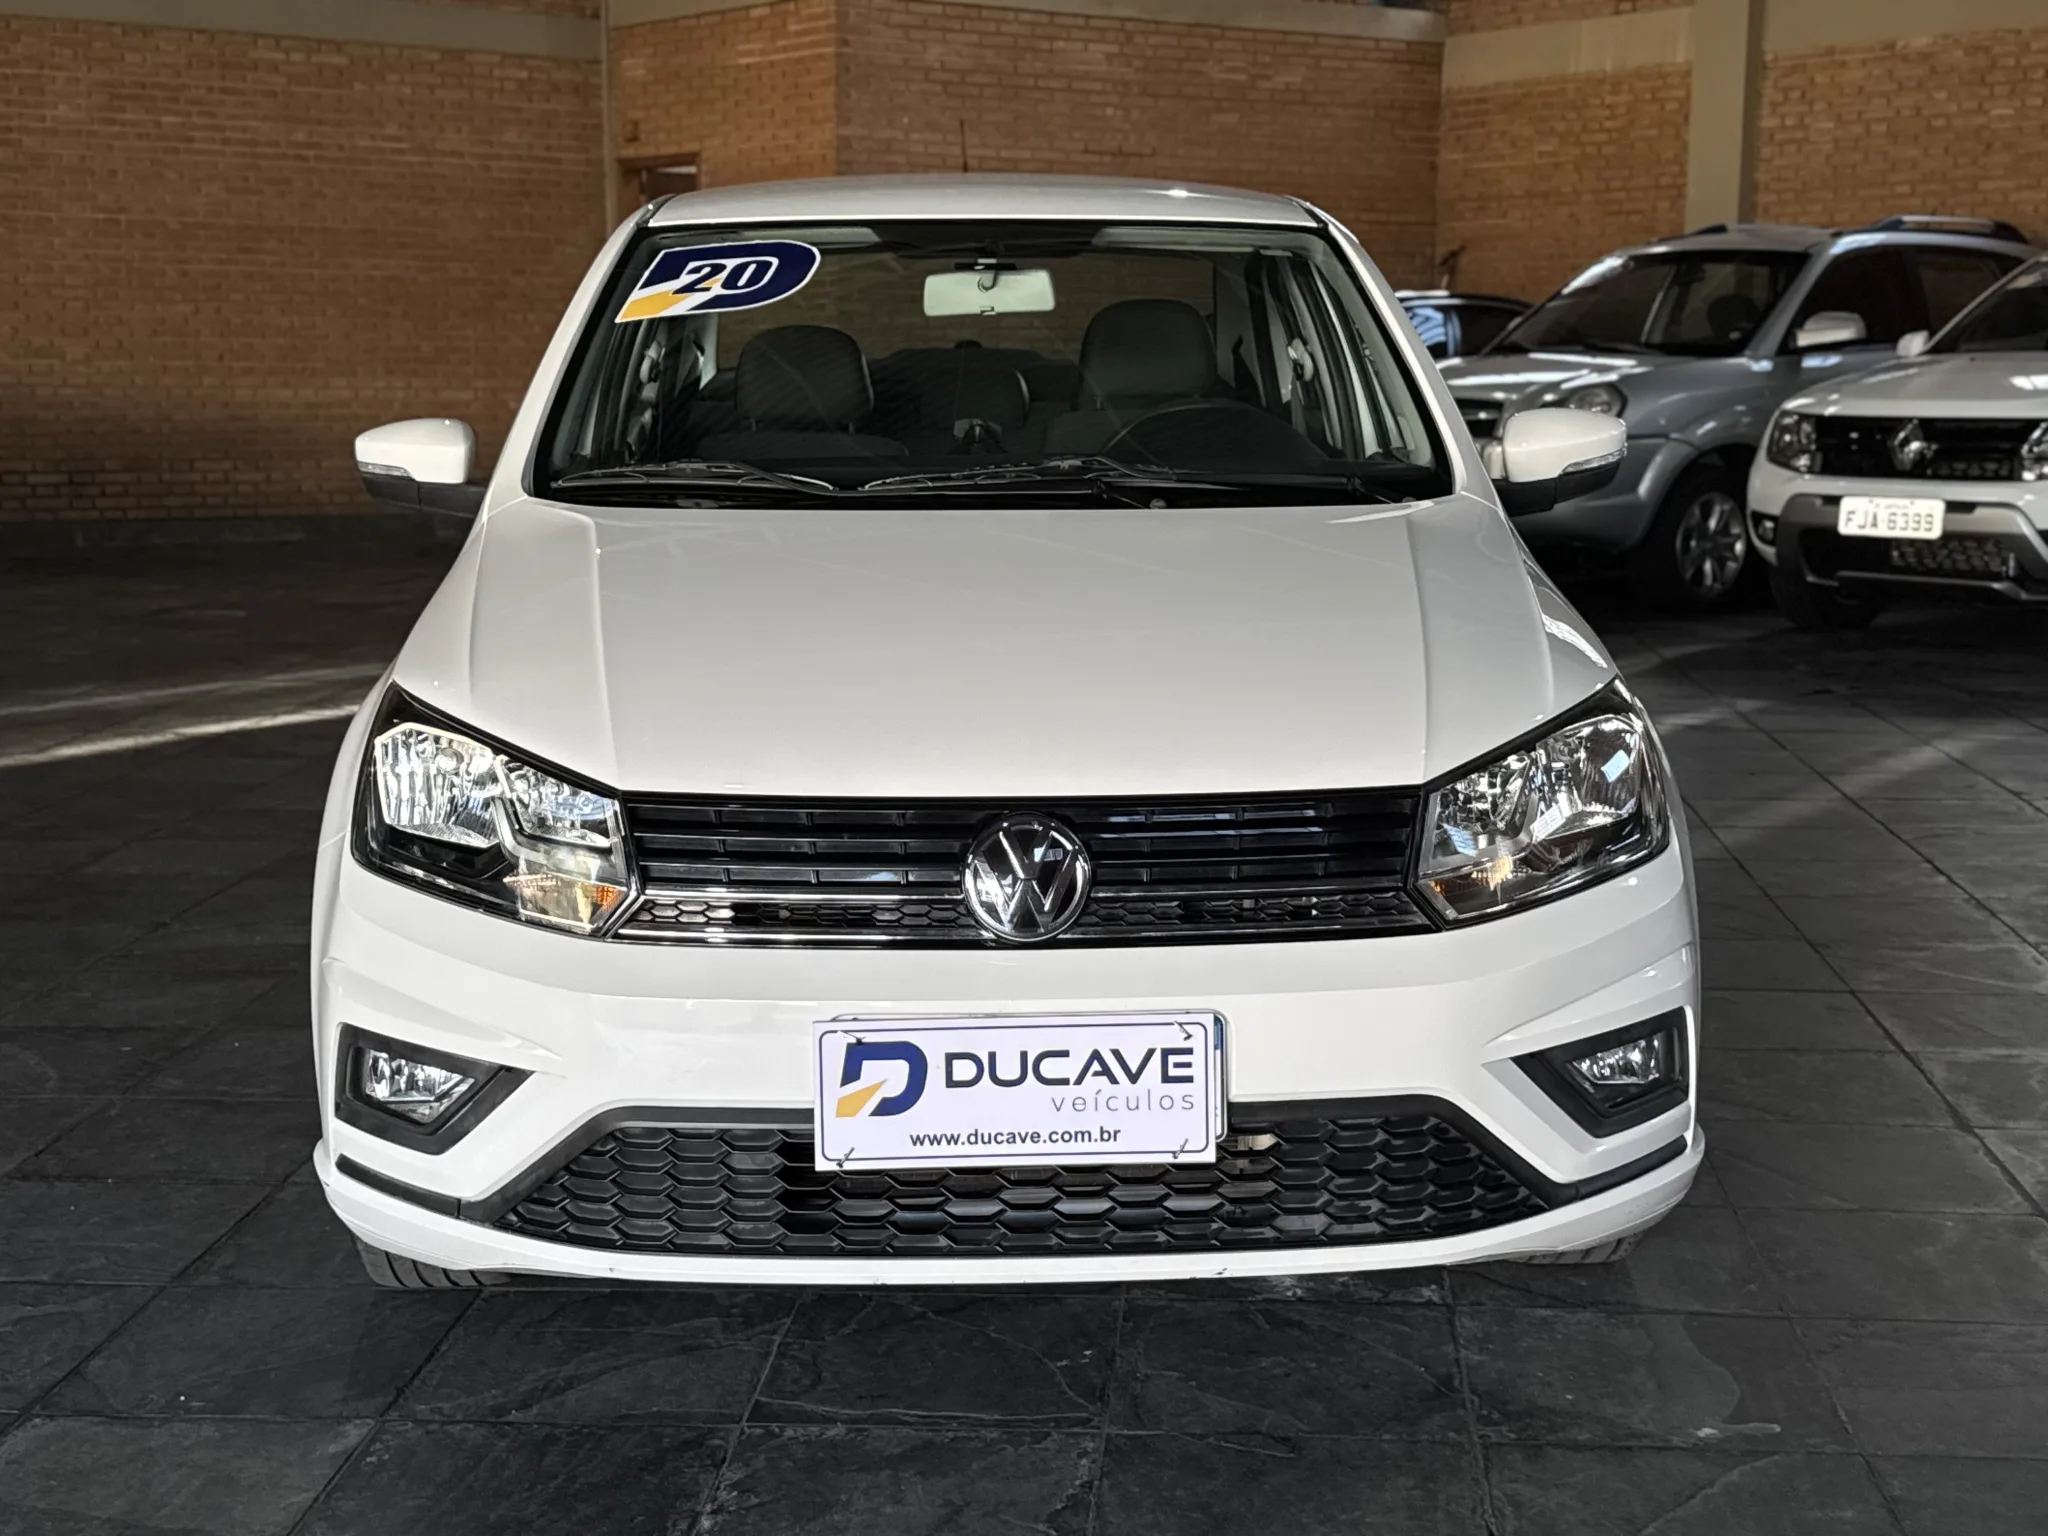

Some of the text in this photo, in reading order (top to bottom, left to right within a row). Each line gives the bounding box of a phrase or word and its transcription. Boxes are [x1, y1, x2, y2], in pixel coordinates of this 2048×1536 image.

[672, 259, 774, 296] 20
[1844, 510, 1934, 532] FJA 6399
[945, 1047, 1194, 1088] DUCAVE
[1050, 1088, 1195, 1113] veículos
[909, 1125, 1121, 1147] www.ducave.com.br
